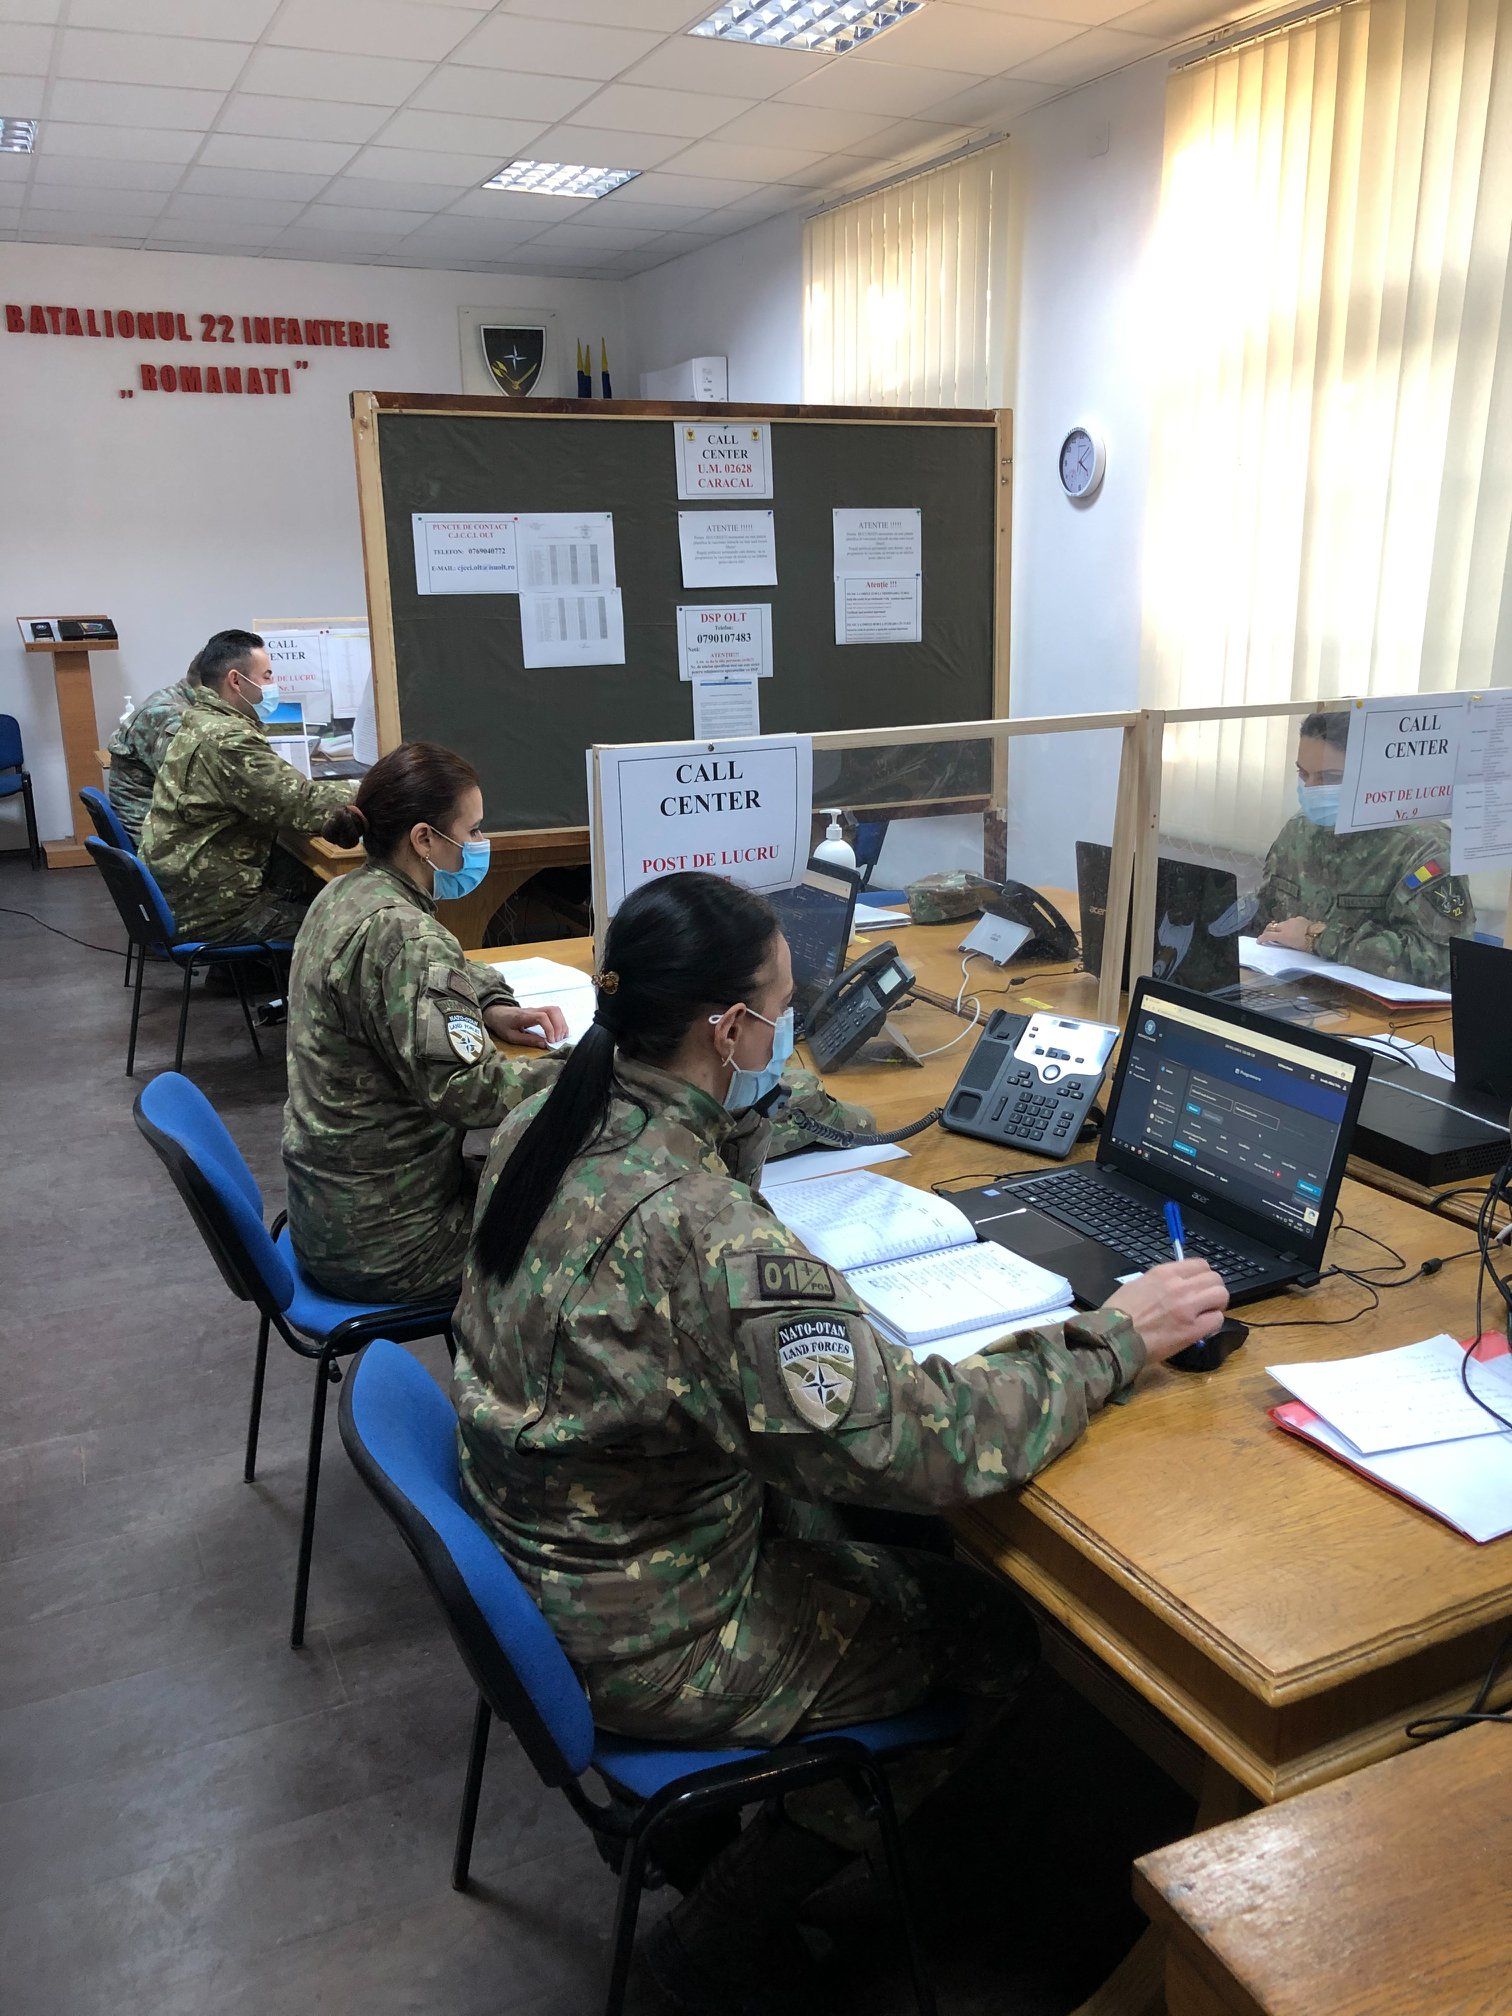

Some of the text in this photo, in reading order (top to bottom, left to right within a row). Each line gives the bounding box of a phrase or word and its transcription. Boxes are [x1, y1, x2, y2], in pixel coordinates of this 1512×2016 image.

[5, 304, 390, 349] BATALIONUL 22 INFANTERIE
[707, 434, 739, 445] CALL
[702, 449, 748, 459] CENTER
[697, 464, 752, 474] U.M. 02628
[698, 478, 754, 488] CARACAL
[701, 612, 747, 623] DSP OLT
[268, 640, 298, 649] CALL
[697, 632, 751, 644] 0790107483
[268, 651, 306, 661] ENTER
[1399, 714, 1442, 733] CALL
[1385, 738, 1449, 759] CENTER
[676, 760, 744, 784] CALL
[1364, 784, 1454, 804] POST DE LUCRU
[660, 789, 762, 817] CENTER
[1395, 807, 1419, 821] Nr. 9
[642, 844, 781, 874] POST DE LUCRU
[449, 1023, 463, 1031] LAND
[779, 1321, 846, 1344] NATO-OTAN
[782, 1341, 850, 1362] LAND FORCES
